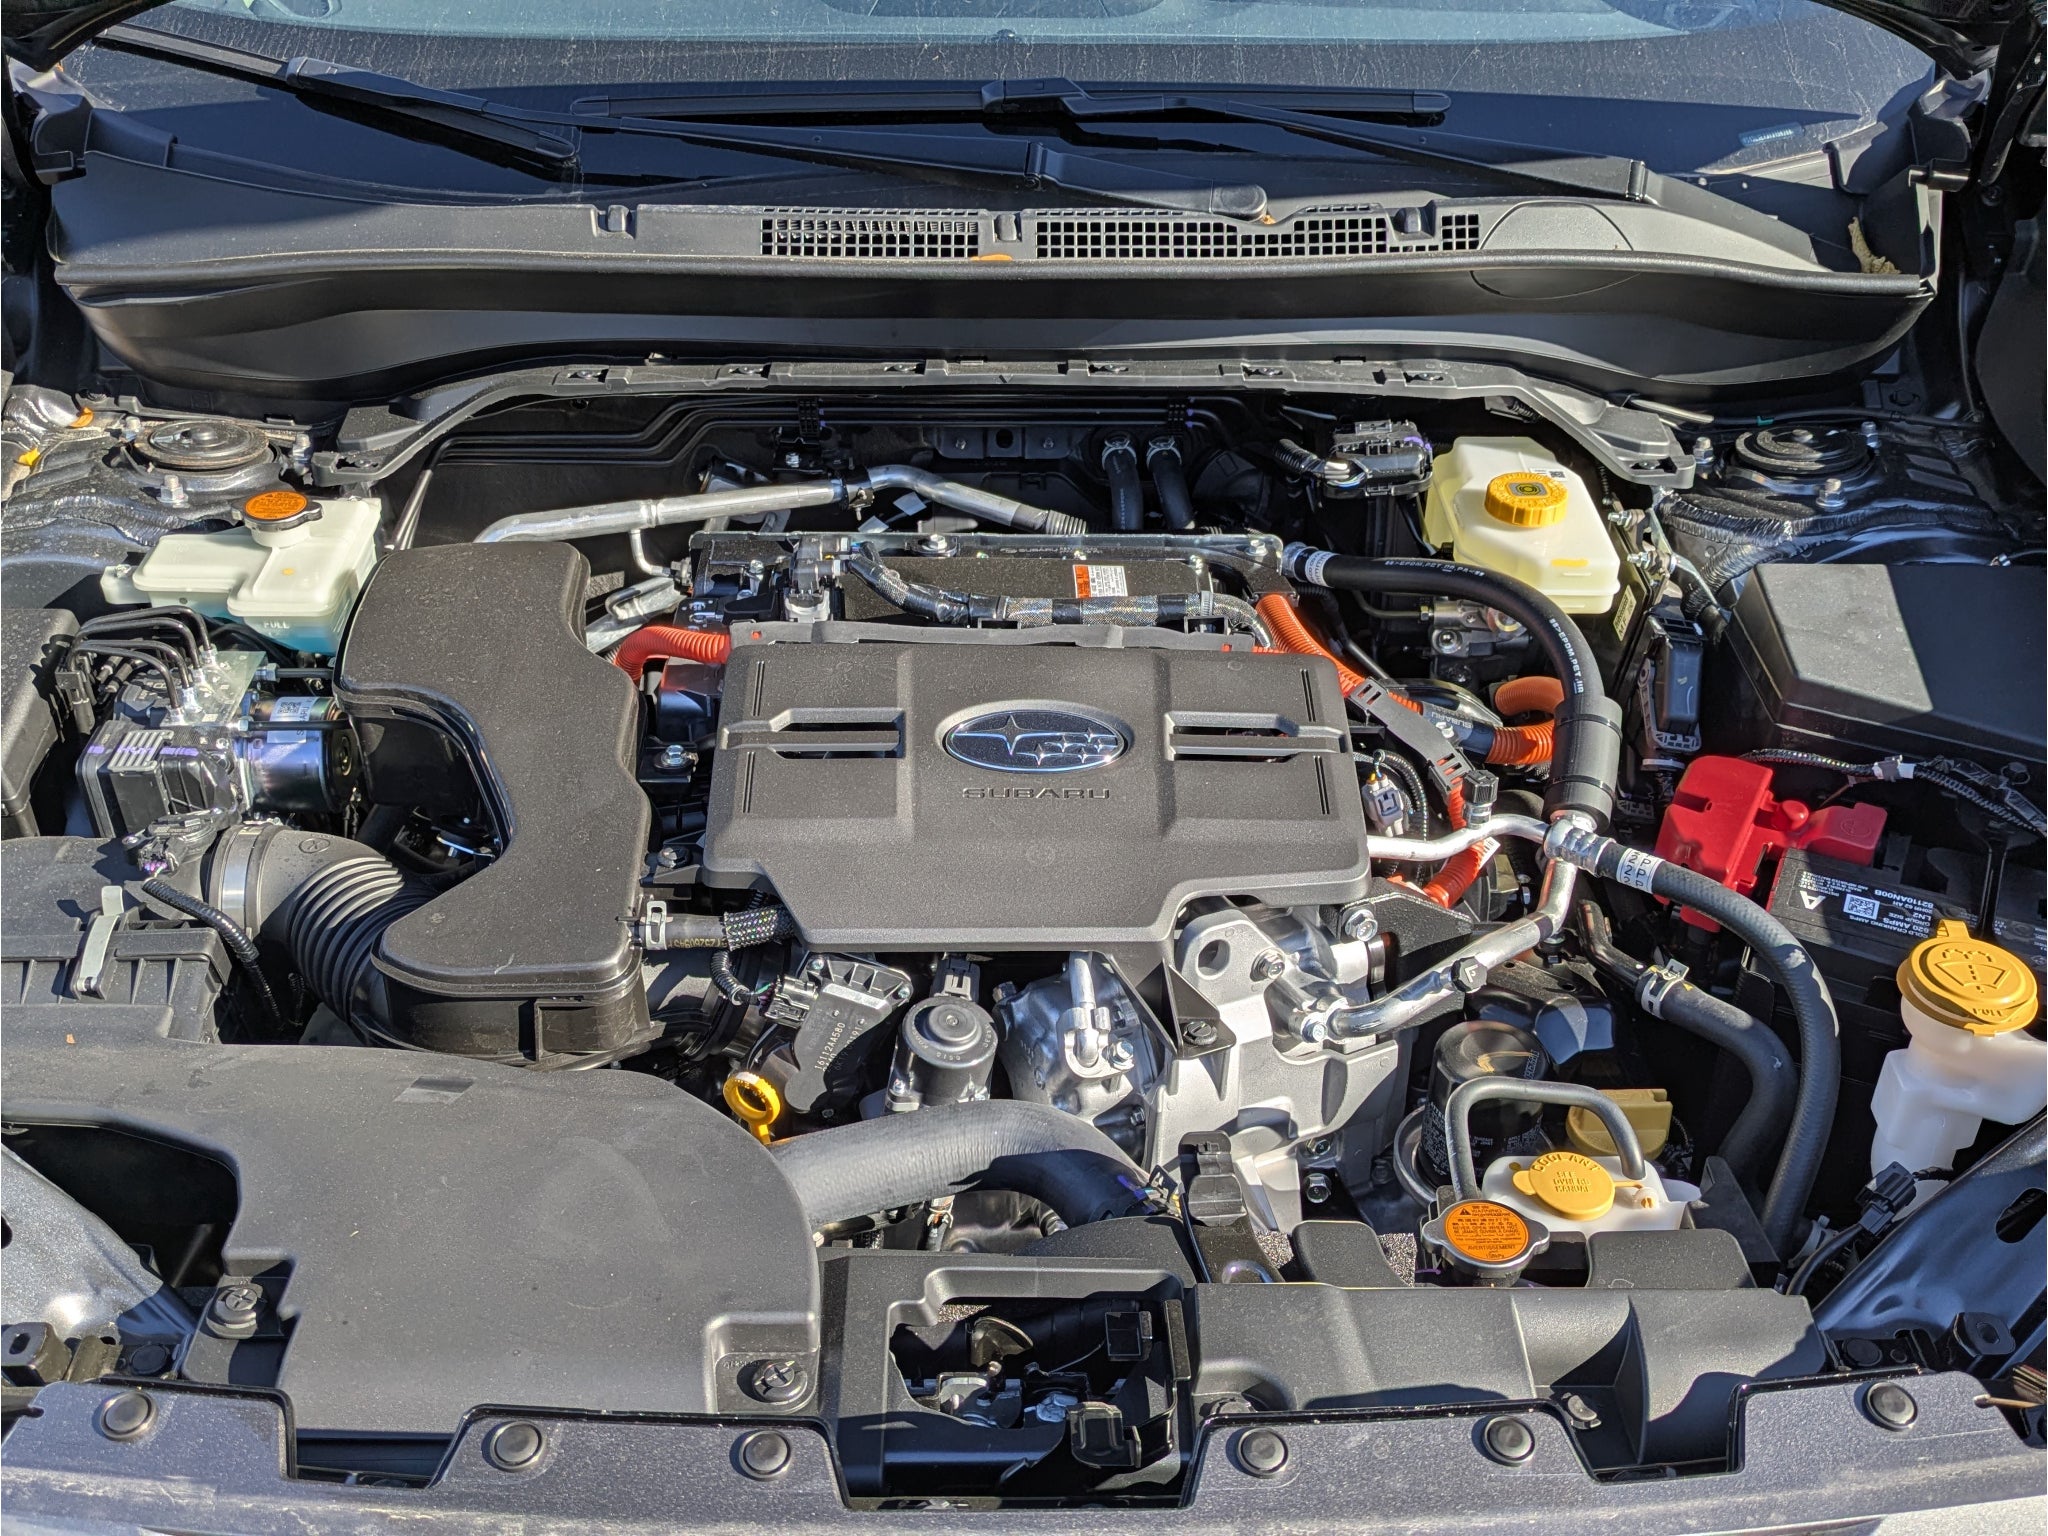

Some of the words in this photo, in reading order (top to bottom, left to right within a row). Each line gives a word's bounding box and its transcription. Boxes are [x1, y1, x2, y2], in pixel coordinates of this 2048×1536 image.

[263, 620, 290, 629] FULL
[962, 787, 1110, 800] SUBARU
[1874, 889, 1934, 908] 82110AN00B
[1849, 915, 1869, 924] AMPS
[1888, 912, 1904, 920] SIZE
[1913, 912, 1931, 921] LN2
[1883, 917, 1911, 929] AMPS
[1905, 917, 1930, 926] GROUP
[1870, 920, 1907, 933] CRANKING
[1912, 925, 1929, 933] 620
[1908, 930, 1929, 939] COLD
[814, 1022, 846, 1070] 16112AA580
[1531, 1153, 1601, 1172] COOLANT
[1557, 1171, 1577, 1179] SEE
